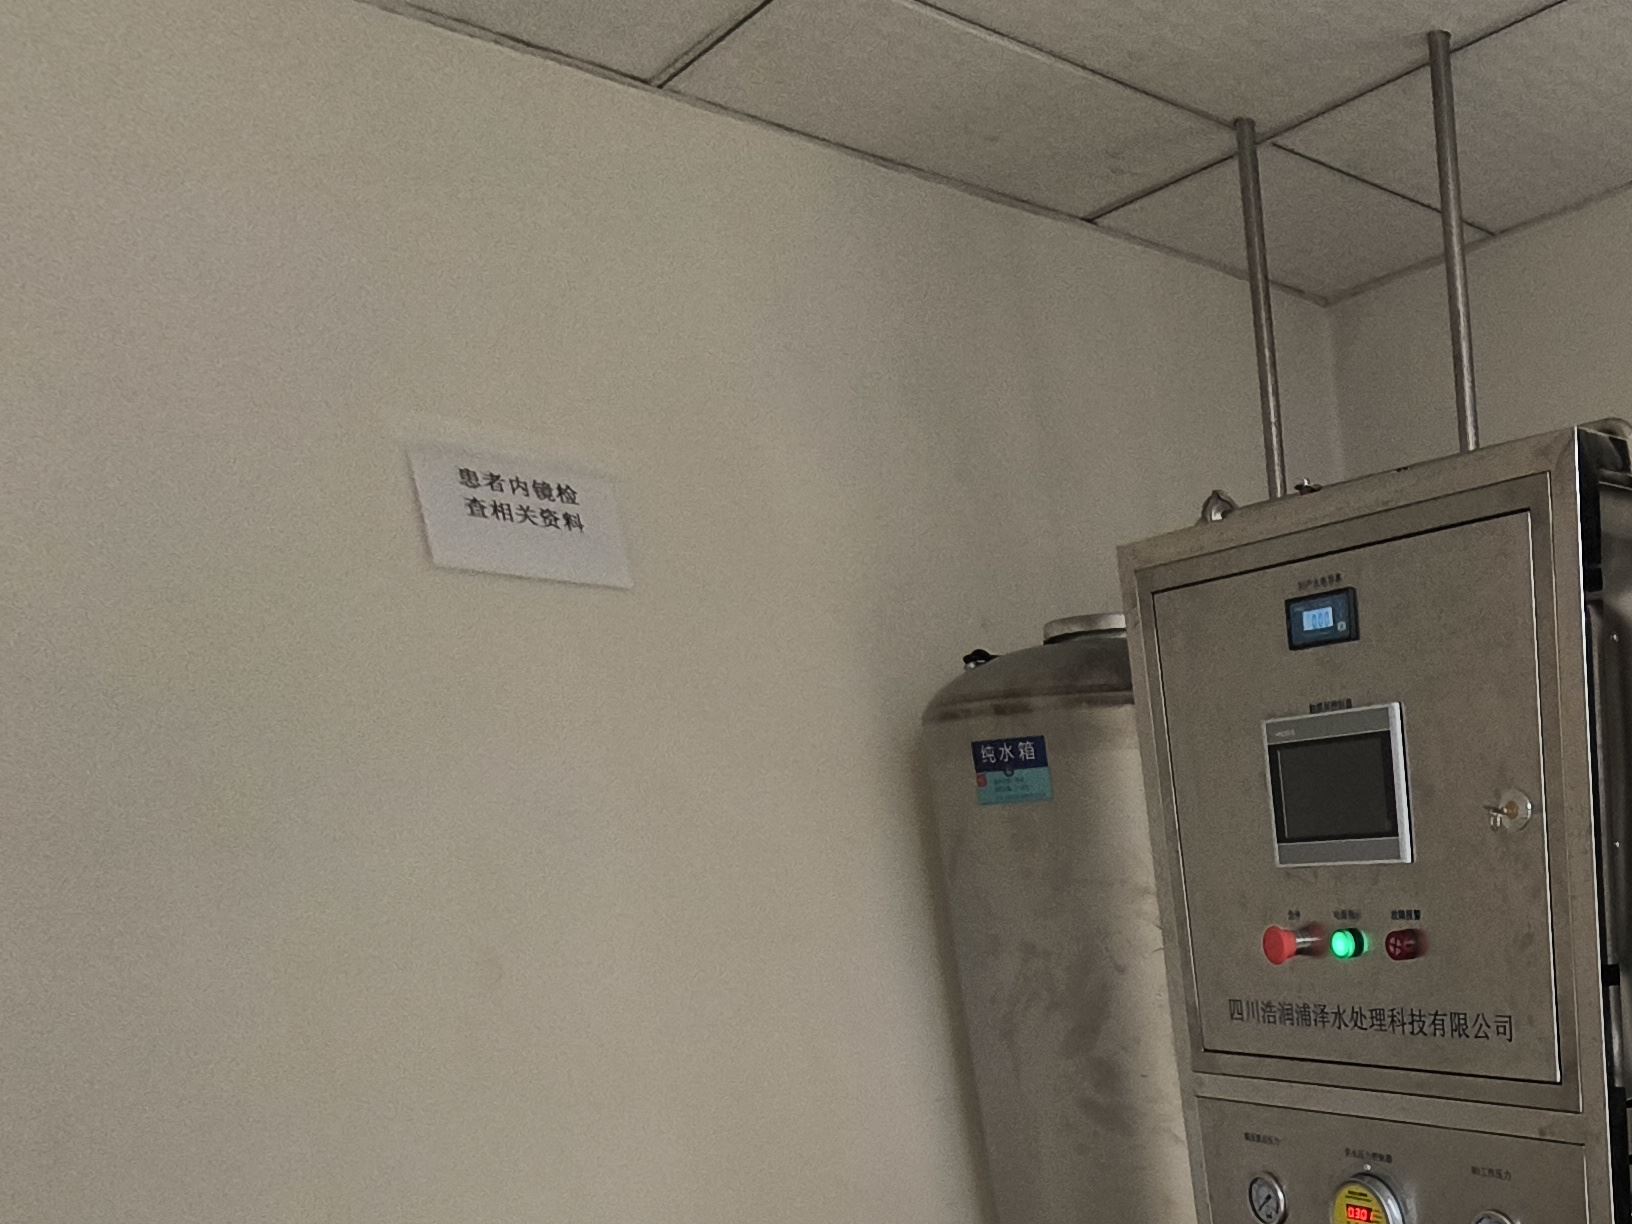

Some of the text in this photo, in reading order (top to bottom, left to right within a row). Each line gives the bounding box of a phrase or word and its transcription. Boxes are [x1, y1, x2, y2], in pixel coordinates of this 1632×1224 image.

[457, 467, 580, 506] 患者内镜检
[466, 496, 584, 533] 查相关资料
